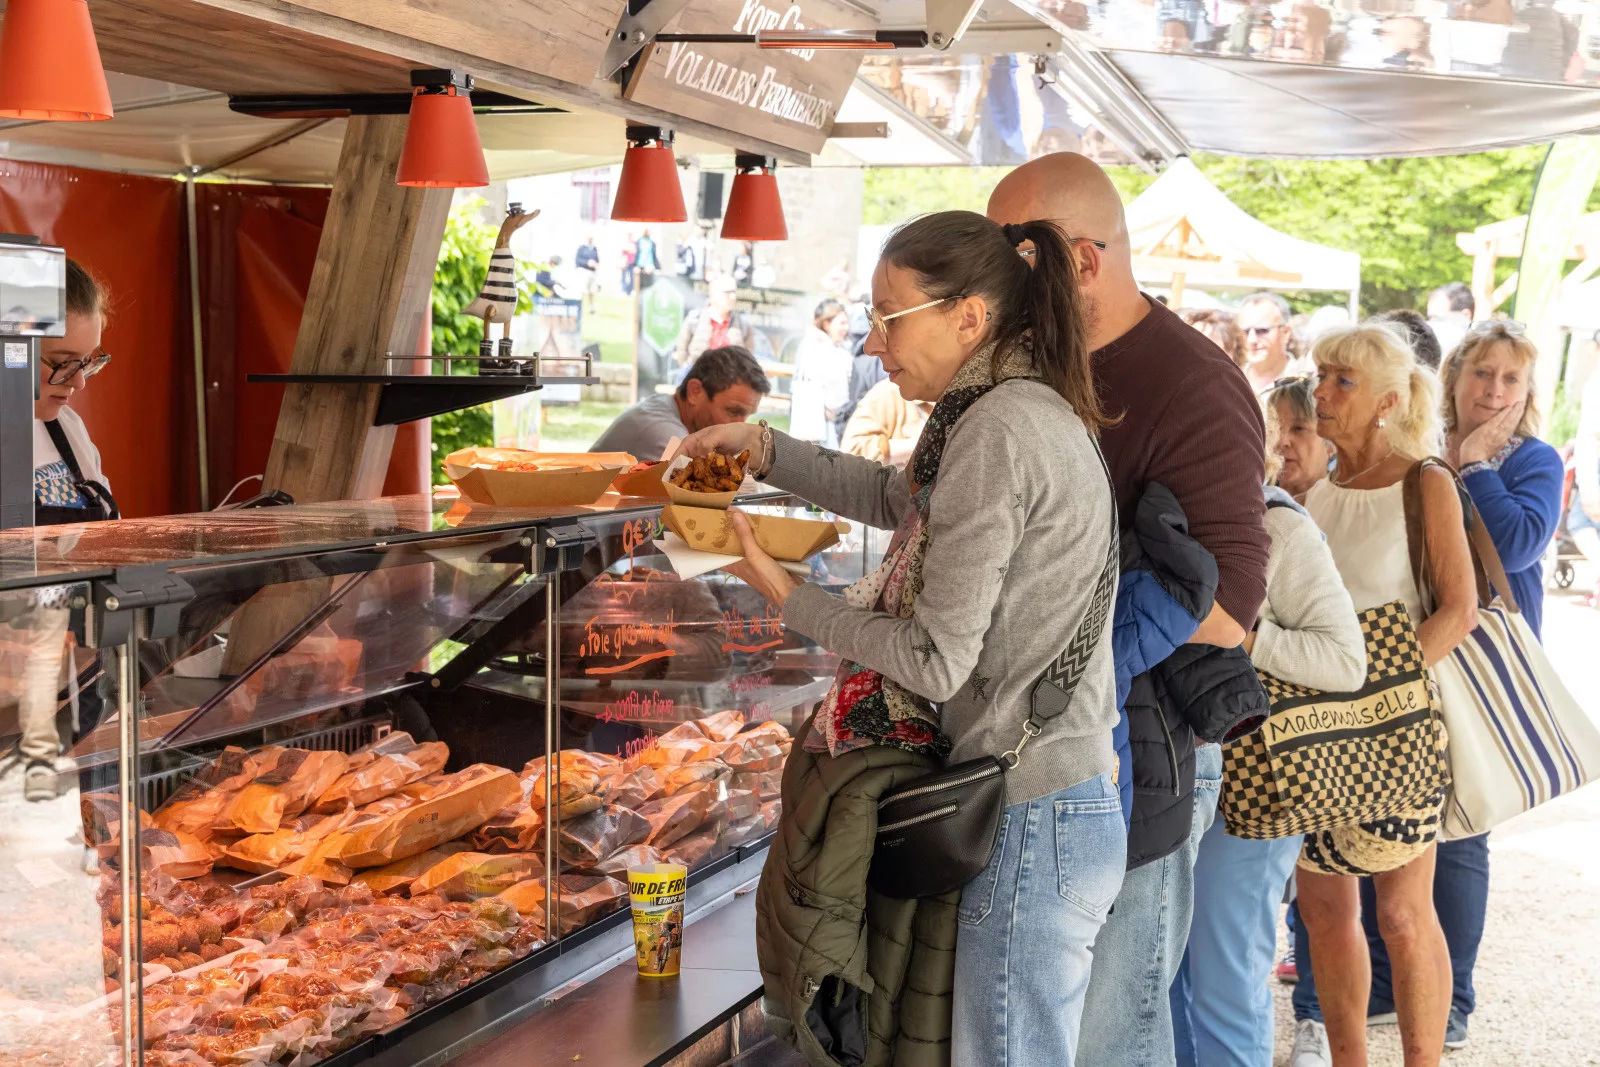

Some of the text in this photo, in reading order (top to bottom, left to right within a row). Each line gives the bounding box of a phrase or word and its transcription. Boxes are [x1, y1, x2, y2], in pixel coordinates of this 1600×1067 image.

[664, 33, 757, 106] VOLAILLES
[1269, 690, 1418, 742] Mademoiselle
[647, 881, 667, 895] DE
